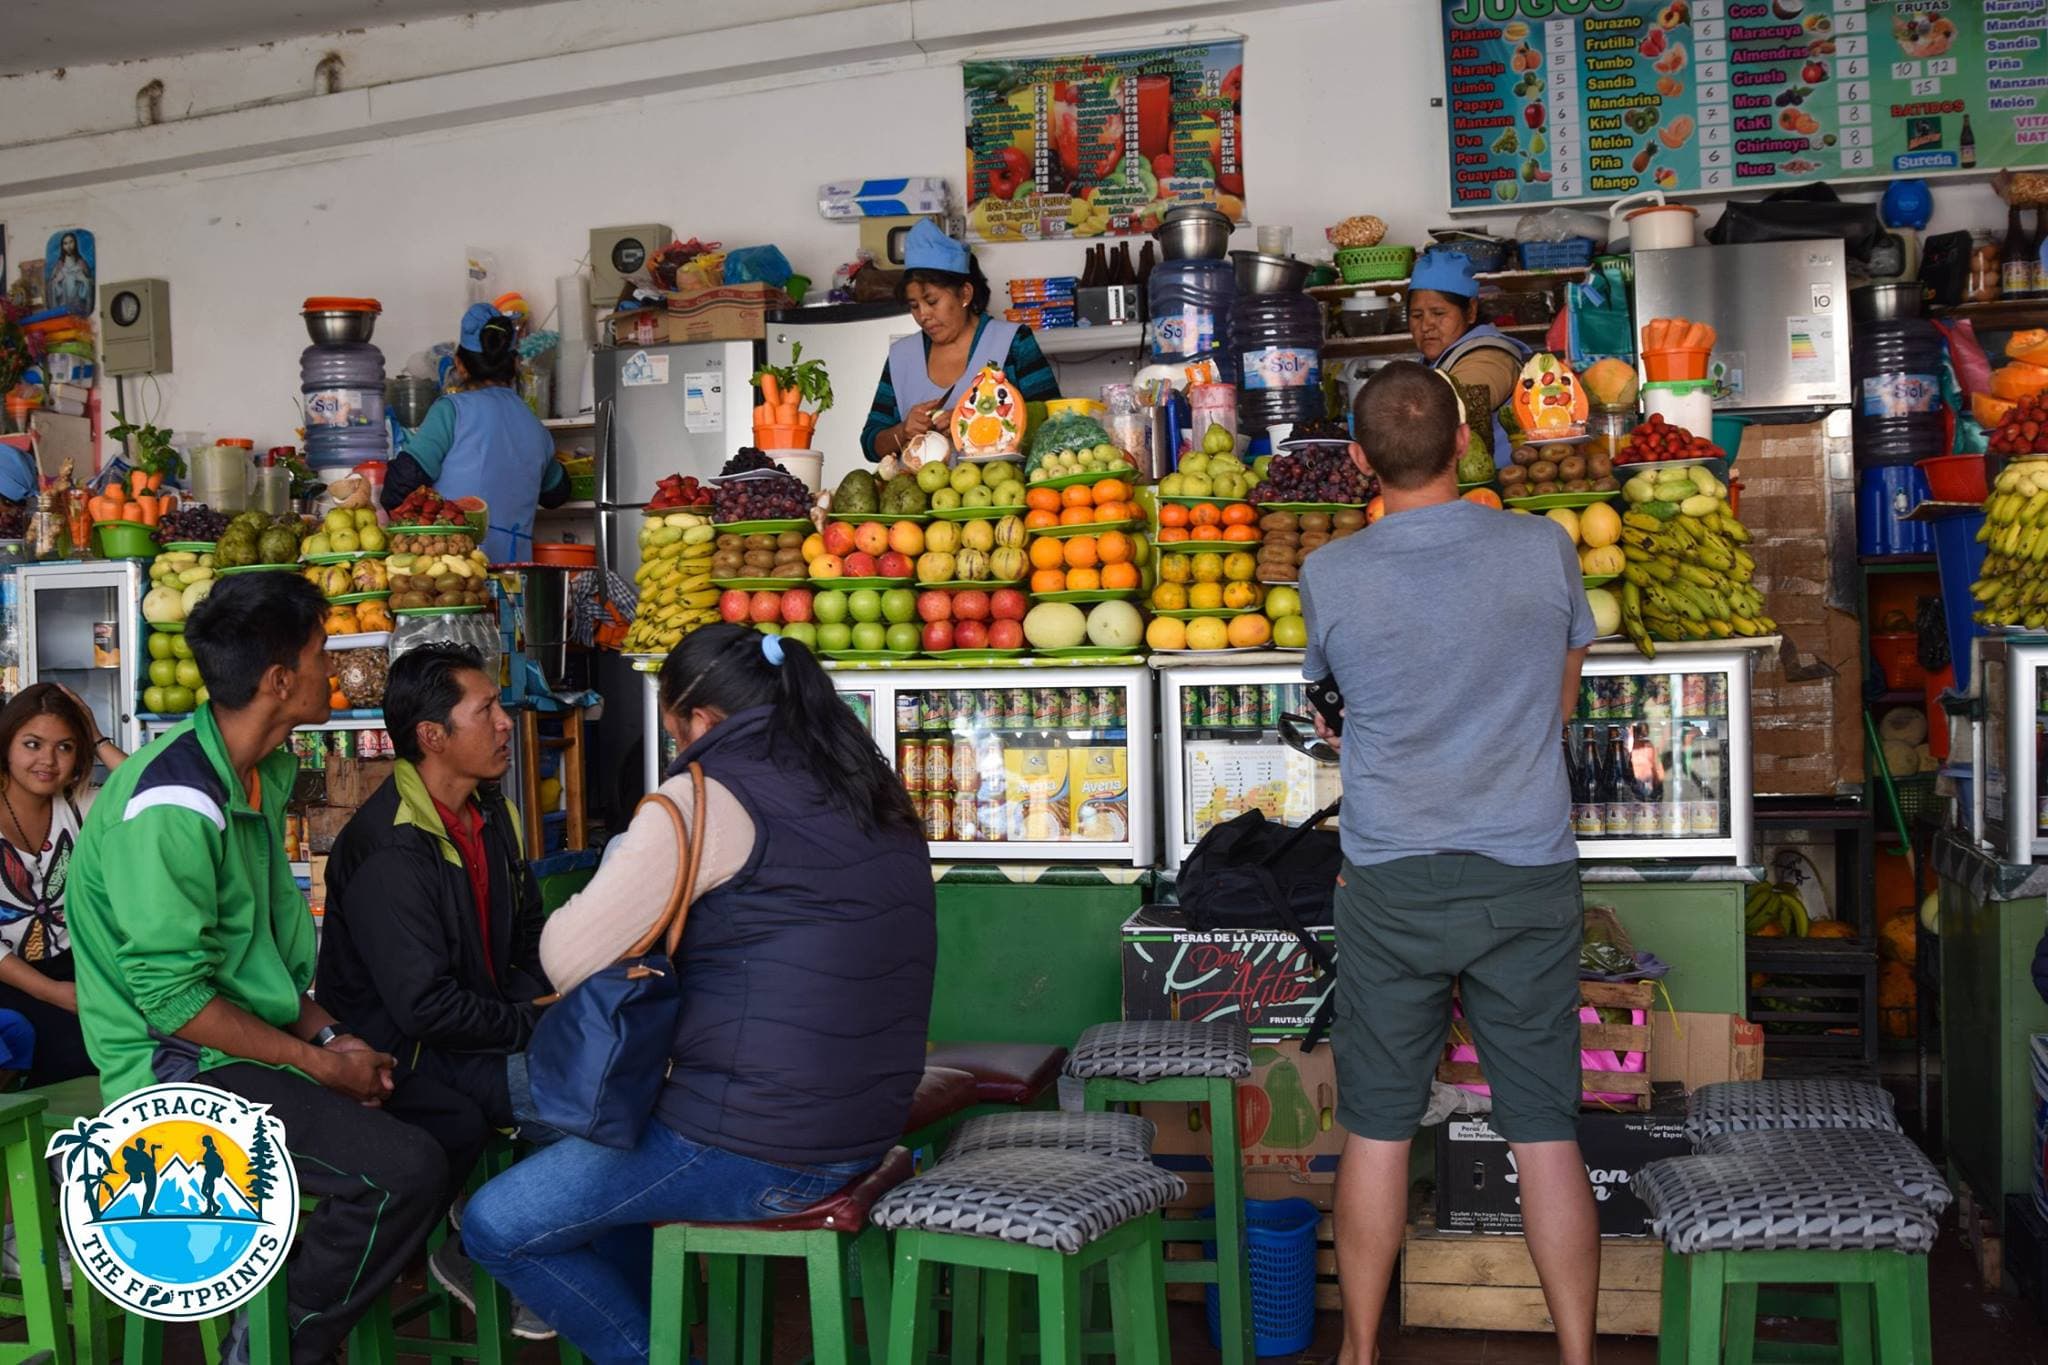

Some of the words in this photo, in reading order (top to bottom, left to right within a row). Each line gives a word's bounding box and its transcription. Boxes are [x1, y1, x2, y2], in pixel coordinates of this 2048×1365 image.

[1701, 4, 1710, 16] 6
[1729, 5, 1767, 18] Coco
[1896, 1, 1951, 13] FRUTAS
[1985, 0, 2044, 12] Naranja
[1554, 21, 1564, 31] 5
[1585, 17, 1641, 31] Durazno
[1703, 24, 1711, 36] 6
[1846, 17, 1854, 30] 6
[1451, 29, 1502, 41] Platano
[1554, 36, 1564, 48] 5
[1586, 36, 1635, 51] Frutilla
[1848, 40, 1857, 53] 7
[1452, 47, 1478, 59] Alfa
[1704, 44, 1713, 56] 6
[1733, 46, 1809, 63] Almendras
[1554, 55, 1565, 66] 5
[1587, 57, 1633, 71] Tumbo
[1849, 60, 1857, 74] 6
[1988, 58, 2021, 70] Piña
[1452, 62, 1505, 77] Naranja
[1704, 66, 1713, 77] 6
[1894, 62, 1913, 76] 10
[1931, 60, 1949, 74] 12
[1556, 73, 1566, 85] 5
[1733, 69, 1786, 86] Ciruela
[1706, 87, 1714, 98] 6
[1848, 84, 1857, 100] 6
[1916, 80, 1932, 95] 15
[1556, 91, 1565, 101] 5
[1588, 95, 1661, 110] Mandarina
[1734, 95, 1771, 109] Mora
[1174, 98, 1232, 112] ZUMOS
[1454, 99, 1503, 113] Papaya
[1890, 99, 1965, 118] BATIDOS
[1558, 108, 1566, 119] 6
[1707, 108, 1718, 120] 7
[1455, 116, 1514, 129] Manzana
[1590, 115, 1621, 130] Kiwi
[1560, 126, 1567, 138] 6
[1455, 135, 1482, 147] Uva
[1736, 138, 1809, 154] Chirimoya
[1560, 145, 1567, 156] 6
[1708, 150, 1720, 162] 6
[1456, 153, 1487, 165] Pera
[1591, 156, 1622, 170] Piña
[1898, 155, 1953, 169] Sureña
[1560, 162, 1568, 173] 6
[1737, 163, 1775, 177] Nuez
[1457, 167, 1516, 183] Guayaba
[1708, 171, 1719, 184] 6
[1561, 181, 1569, 192] 6
[1592, 176, 1638, 190] Mango
[1458, 188, 1490, 200] Tuna
[1270, 356, 1299, 373] Sol
[1893, 383, 1924, 400] Sol
[314, 398, 339, 413] Sol
[1173, 933, 1211, 943] PERAS
[1214, 933, 1231, 943] DE
[1233, 933, 1248, 943] LA
[1188, 944, 1245, 974] Don
[1178, 945, 1315, 1025] Atilio
[1269, 1016, 1300, 1024] FRUTAS
[1662, 1131, 1685, 1140] Expor
